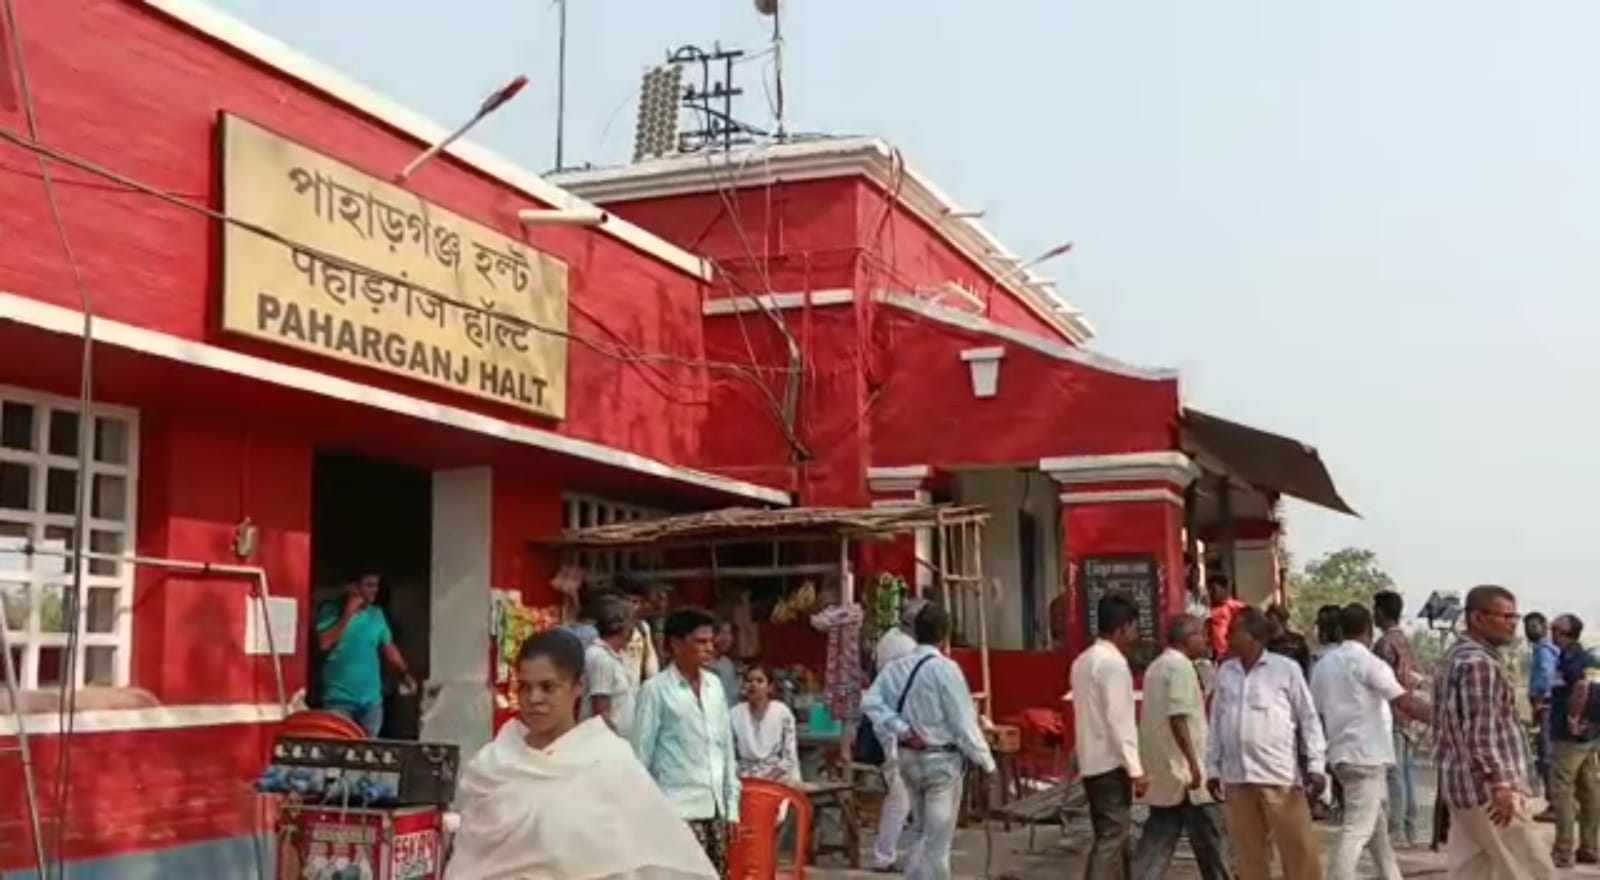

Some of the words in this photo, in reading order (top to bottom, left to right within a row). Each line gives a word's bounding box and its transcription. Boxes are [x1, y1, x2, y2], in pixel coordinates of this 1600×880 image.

[288, 166, 461, 272] পাহাড়গঞ্জ
[471, 241, 530, 292] হল্ট
[257, 294, 469, 385] PAHARGANJ
[479, 361, 548, 406] HALT
[291, 247, 445, 328] पहाड़गंज
[463, 296, 530, 351] हॉल्ट
